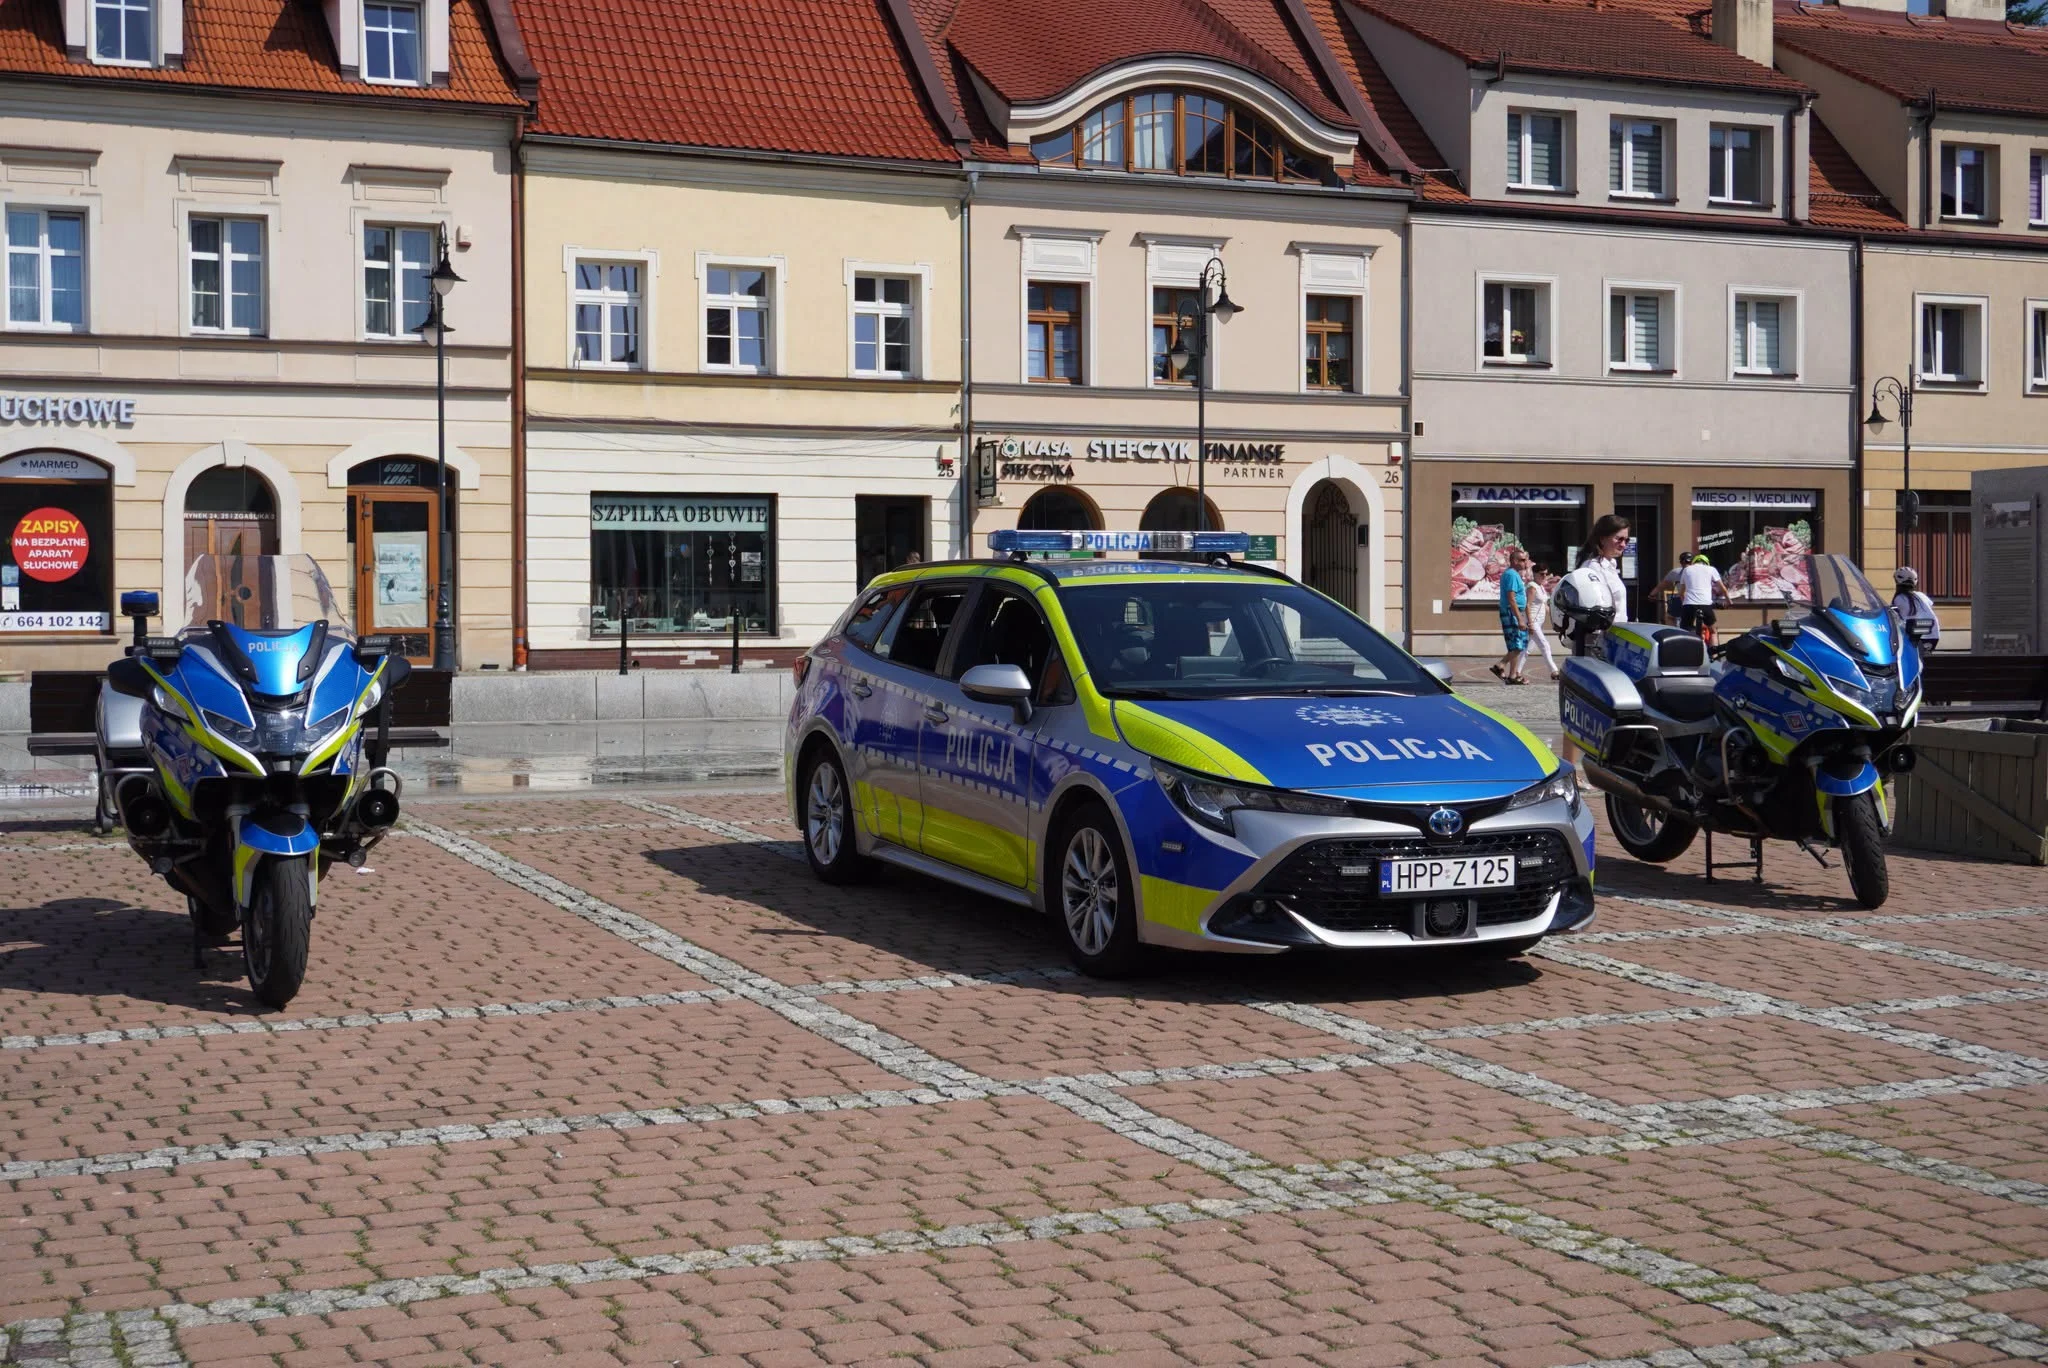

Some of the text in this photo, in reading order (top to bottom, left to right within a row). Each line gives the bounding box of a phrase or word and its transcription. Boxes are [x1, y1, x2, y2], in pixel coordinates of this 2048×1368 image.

[0, 396, 136, 423] UCHOWE
[1024, 440, 1073, 456] KASA
[1089, 440, 1192, 460] STEFCZYK
[1204, 443, 1286, 463] FINANSE
[29, 460, 79, 470] MARMED
[938, 463, 954, 477] 25
[1223, 467, 1284, 479] PARTNER
[1384, 470, 1399, 484] 26
[1477, 487, 1572, 501] MAXPOL
[592, 504, 768, 523] SZPILKA OBUWIE
[21, 520, 80, 534] ZAPISY
[31, 538, 86, 547] BEZPŁATNE
[1086, 533, 1150, 549] POLICJA
[28, 550, 73, 558] APARATY
[23, 561, 78, 570] SŁUCHOWE
[17, 615, 103, 627] 664 102 142
[1565, 699, 1606, 740] POLICJA
[946, 725, 1016, 785] POLICJA
[1305, 737, 1494, 767] POLICJA
[1398, 858, 1509, 889] HPP Z125
[1381, 880, 1391, 888] PL
